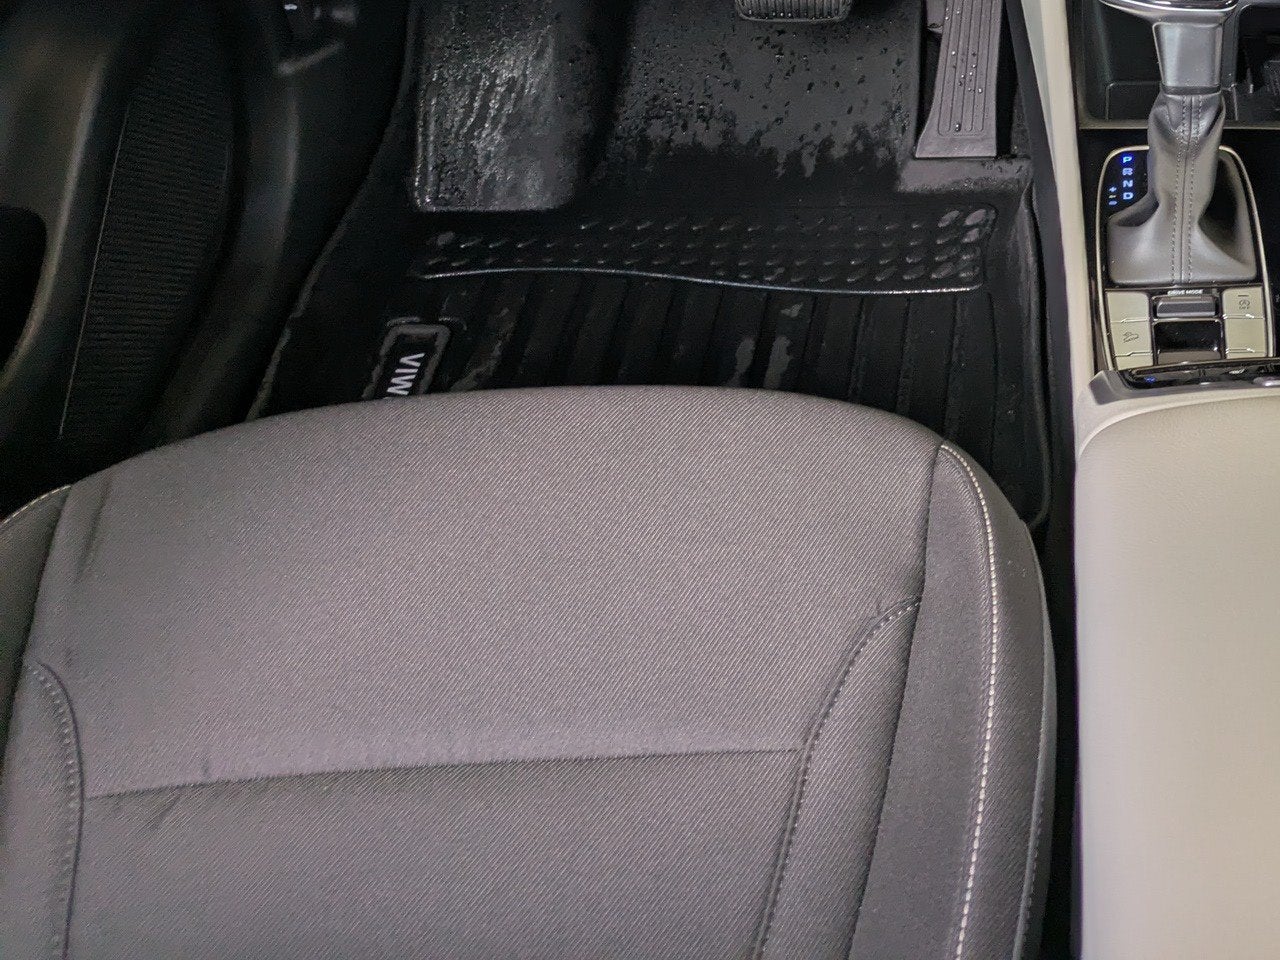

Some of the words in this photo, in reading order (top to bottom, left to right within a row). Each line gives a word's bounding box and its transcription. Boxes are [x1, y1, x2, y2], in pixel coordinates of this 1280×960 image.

[1122, 156, 1133, 164] P
[1122, 167, 1133, 176] R
[1122, 179, 1134, 188] N
[1122, 191, 1134, 200] D
